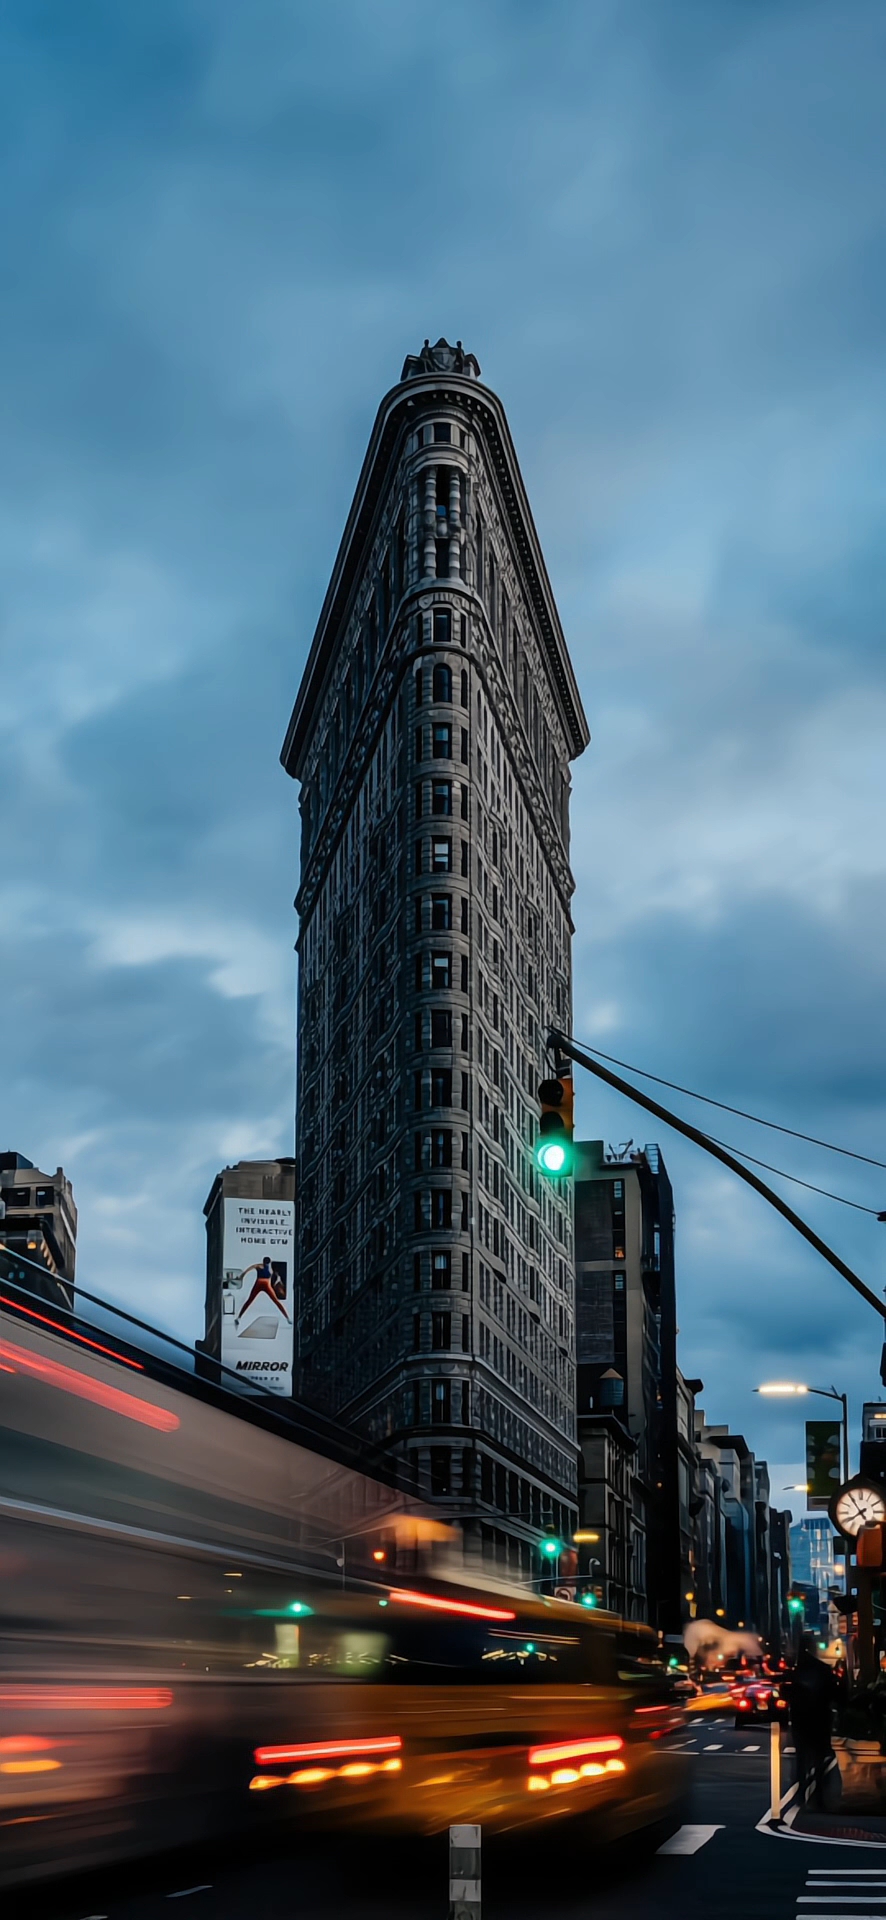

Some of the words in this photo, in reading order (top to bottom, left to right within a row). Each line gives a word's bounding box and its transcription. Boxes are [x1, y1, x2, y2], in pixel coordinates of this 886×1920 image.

[238, 1207, 255, 1215] THE
[259, 1208, 291, 1217] NEARLY
[235, 1226, 293, 1236] INTERACTIVE
[240, 1237, 266, 1245] HOME
[235, 1360, 289, 1372] MIRROR
